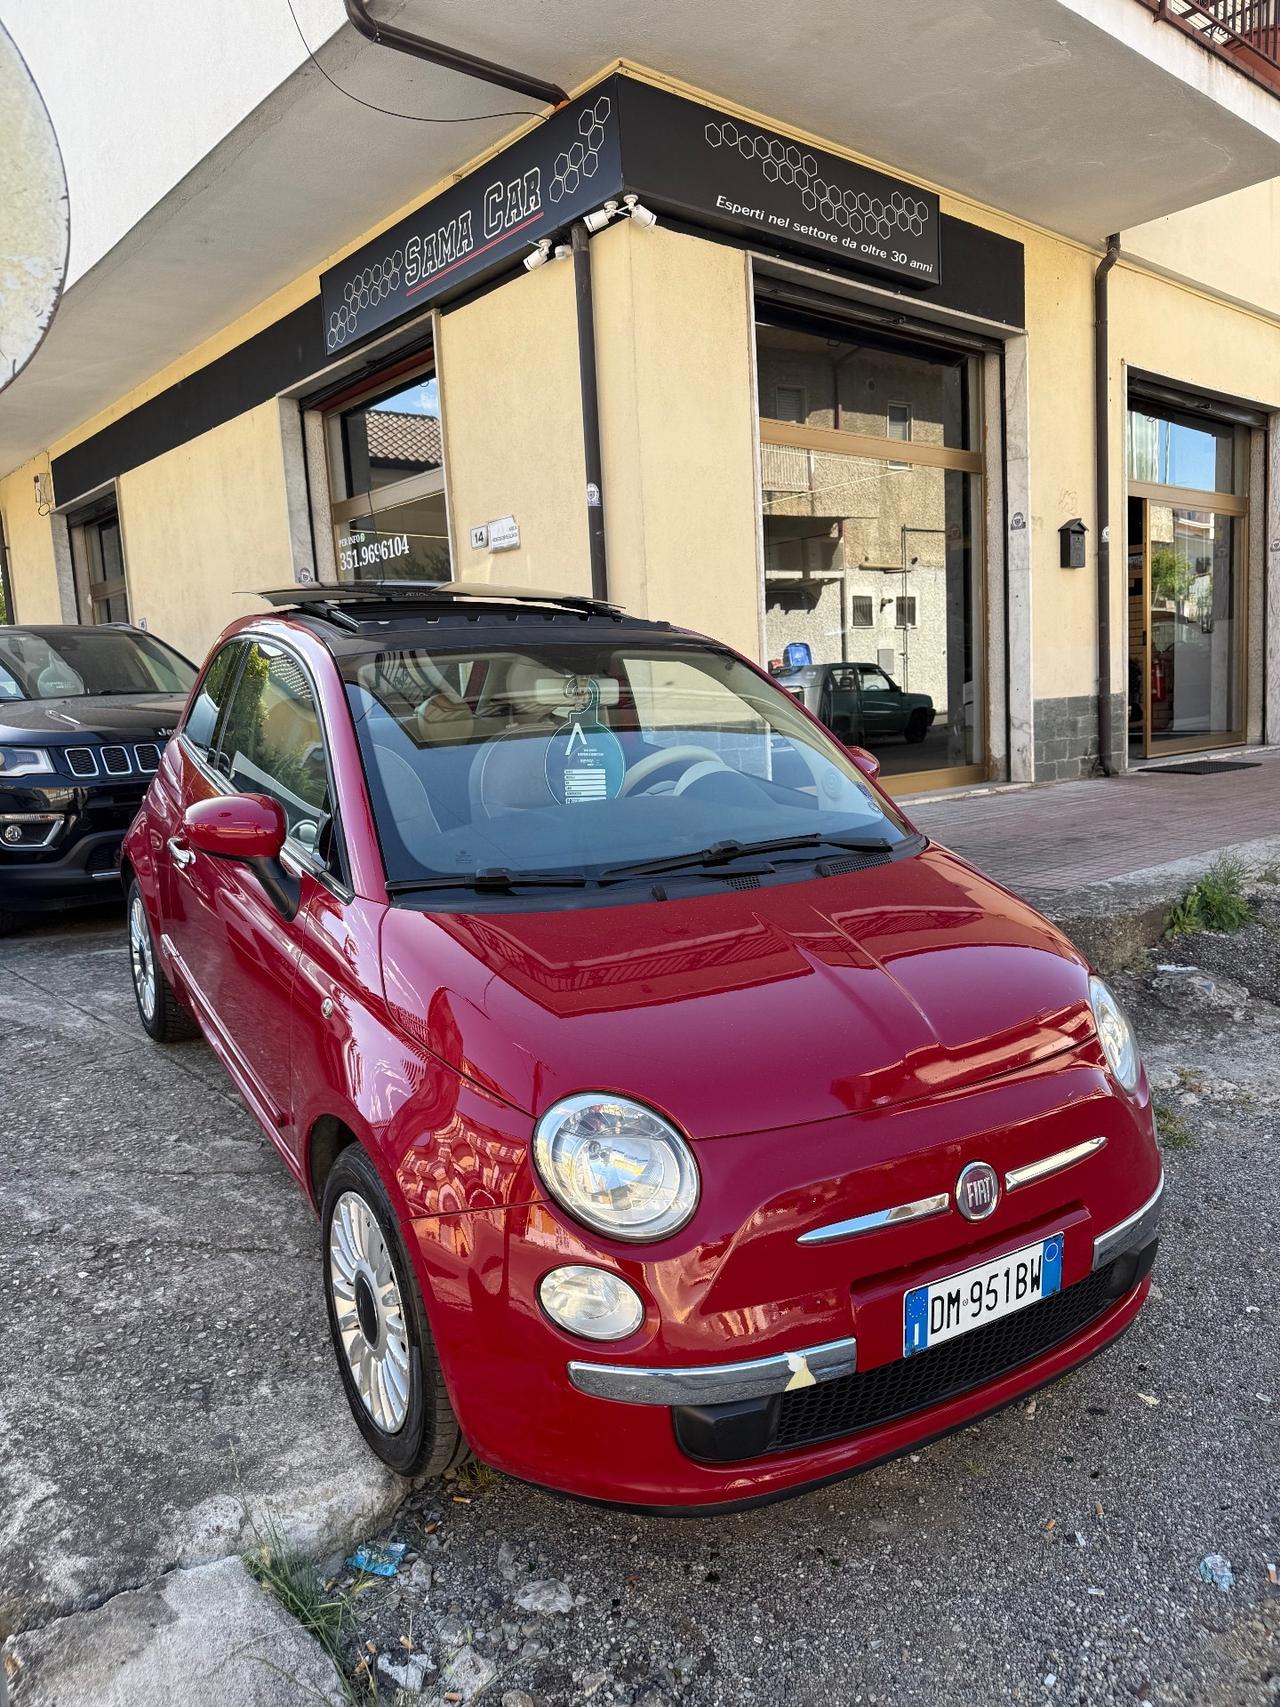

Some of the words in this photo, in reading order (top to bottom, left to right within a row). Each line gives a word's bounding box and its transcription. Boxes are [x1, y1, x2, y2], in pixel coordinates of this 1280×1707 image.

[715, 195, 765, 221] Esperti
[768, 213, 790, 229] nel
[792, 221, 839, 244] settore
[841, 236, 858, 250] da
[860, 243, 888, 260] oltre
[890, 250, 908, 265] 30
[909, 258, 935, 274] anni
[339, 534, 410, 571] 351.9696104
[474, 530, 484, 545] 14
[966, 1175, 995, 1209] FIAT
